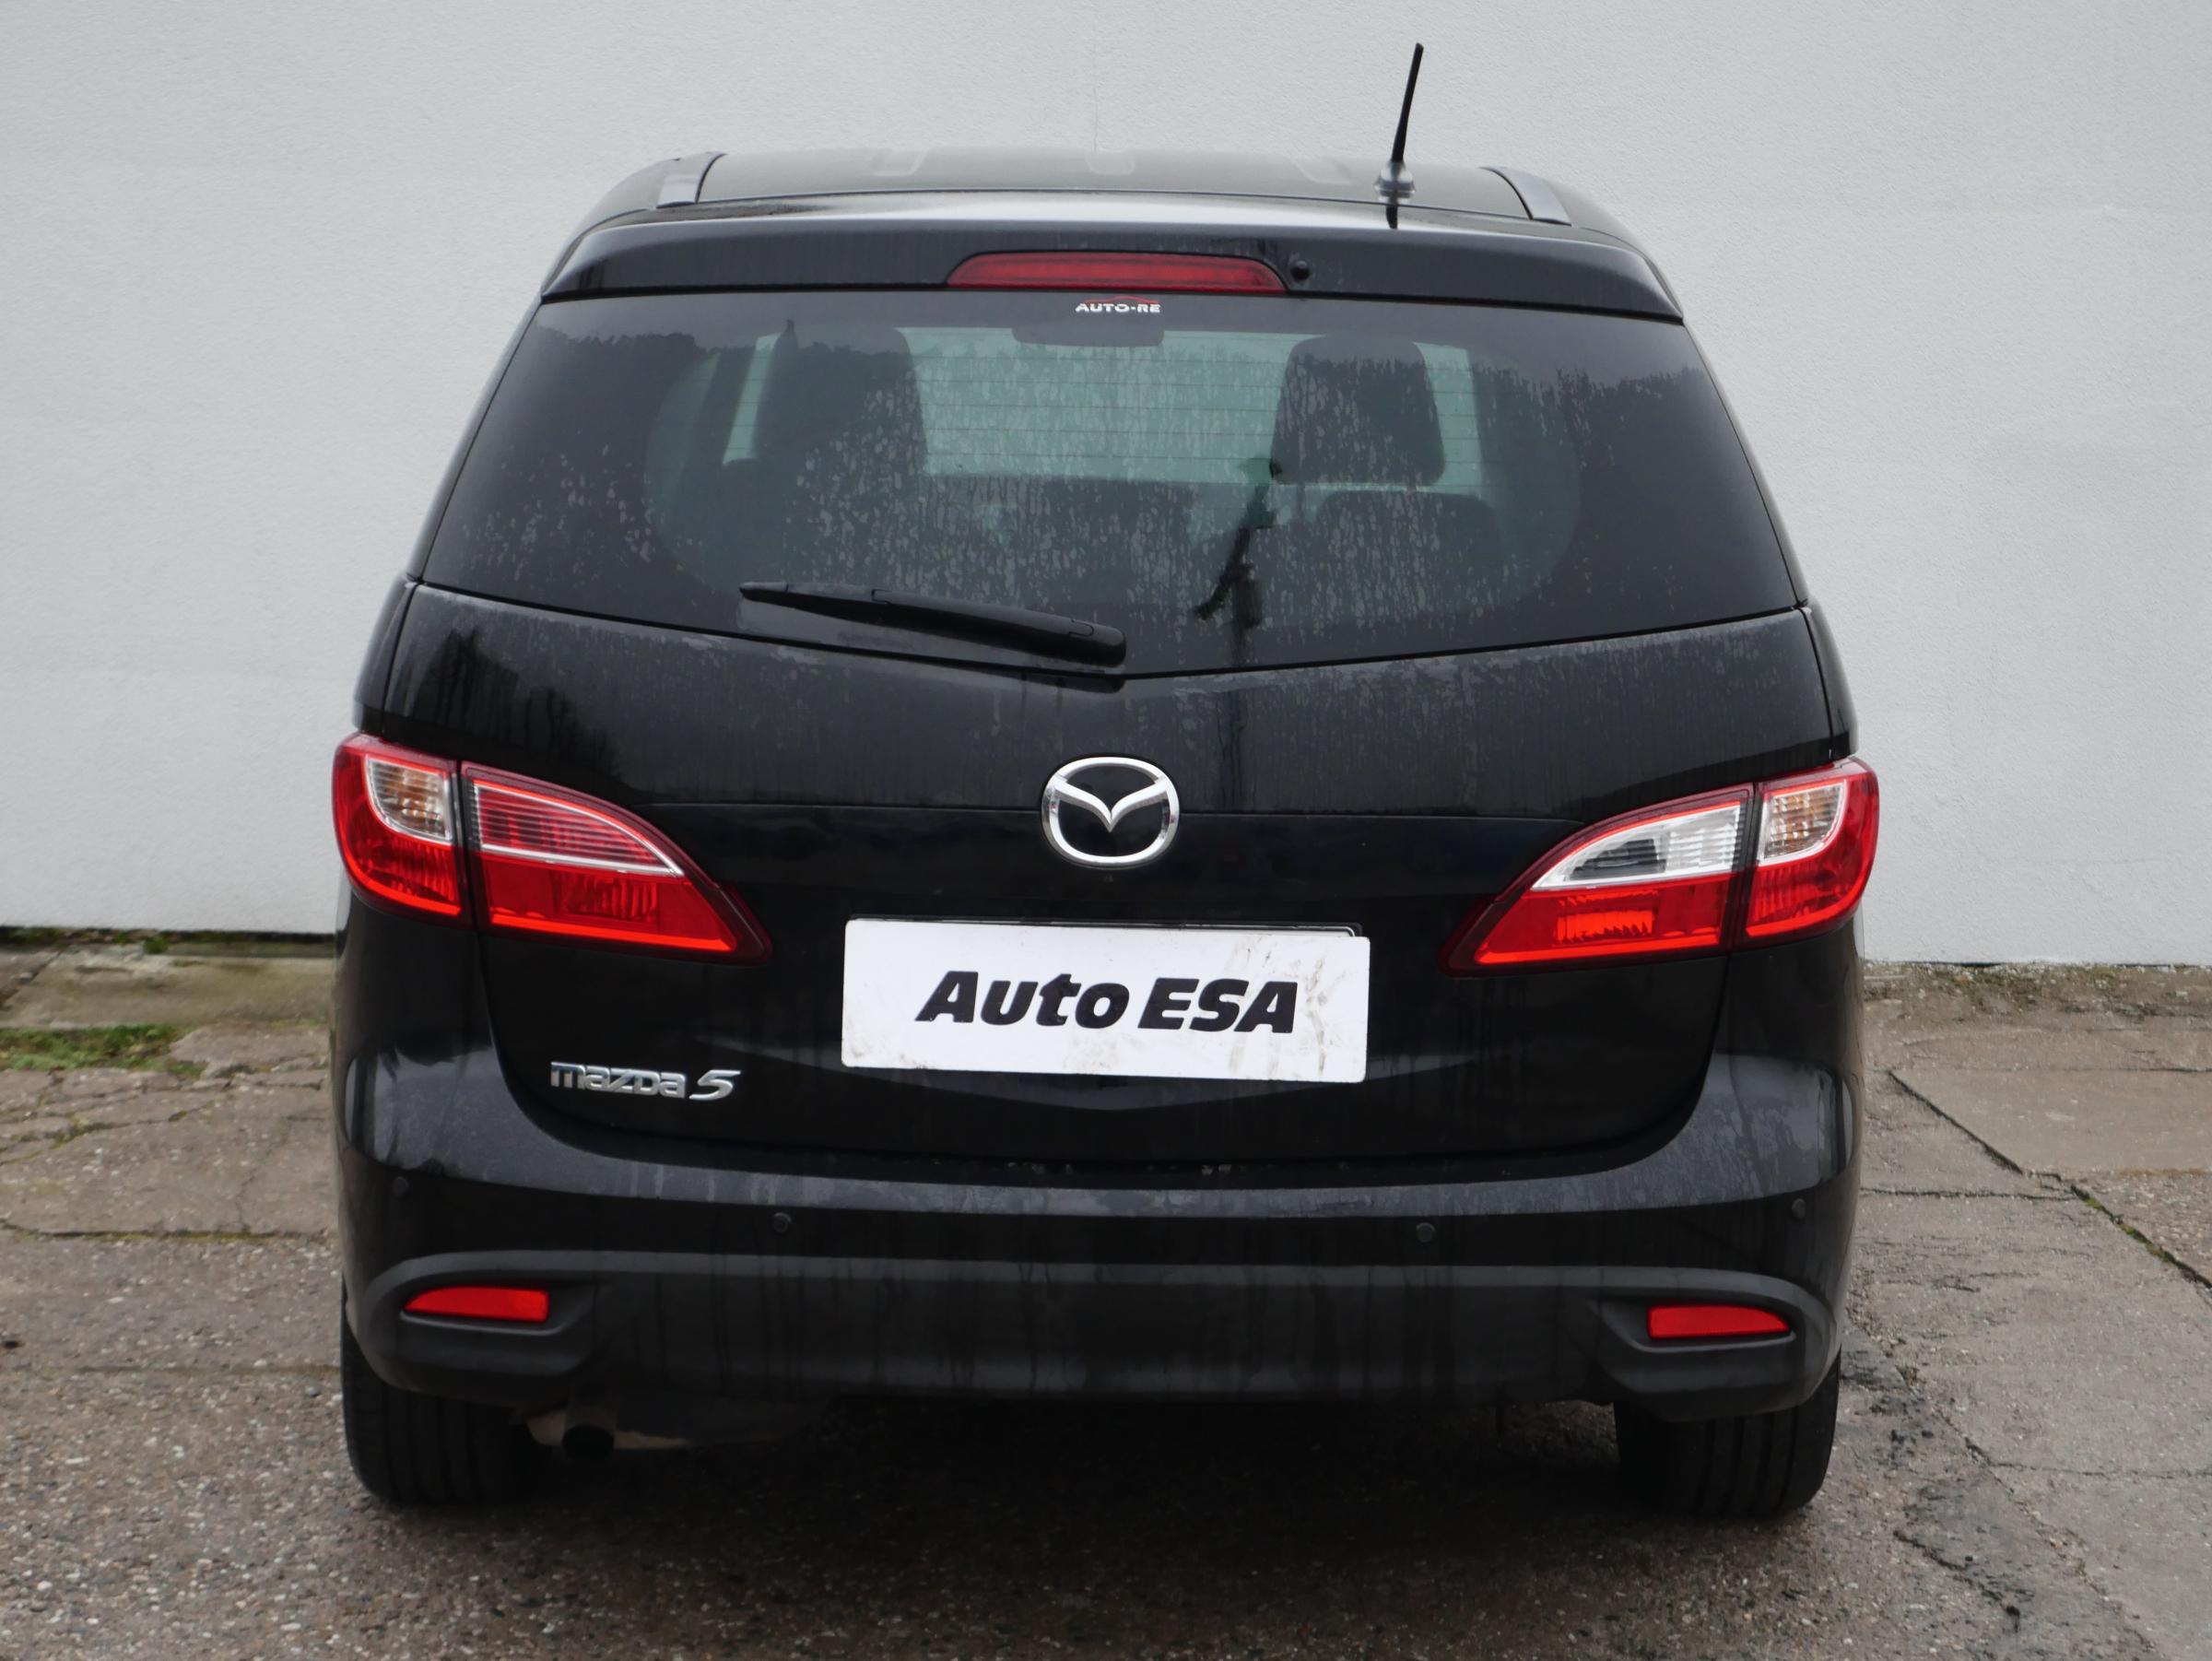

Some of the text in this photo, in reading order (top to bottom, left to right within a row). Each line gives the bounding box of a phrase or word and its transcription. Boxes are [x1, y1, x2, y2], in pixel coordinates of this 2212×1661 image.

[1075, 302, 1161, 313] AUTO-RE
[915, 971, 1298, 1033] Auto ESA
[688, 1069, 741, 1101] 5
